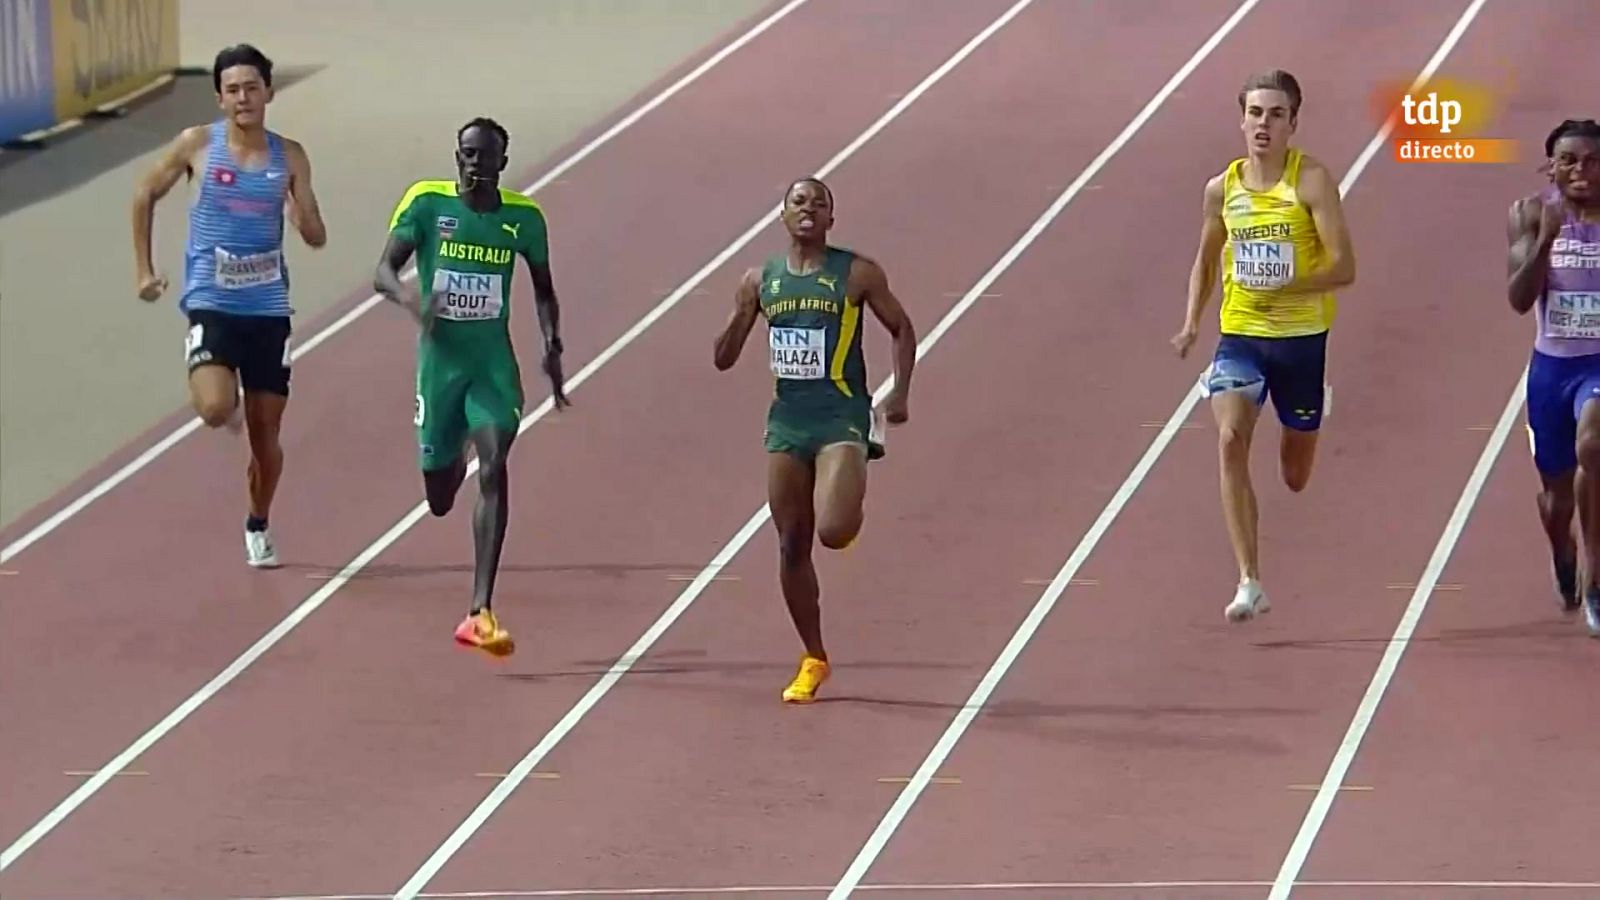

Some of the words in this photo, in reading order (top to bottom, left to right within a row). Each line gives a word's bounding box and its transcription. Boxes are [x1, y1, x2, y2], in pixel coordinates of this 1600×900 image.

[1231, 223, 1290, 240] SWEDEN
[439, 241, 511, 263] AUSTRALIA
[1240, 242, 1281, 259] NTN
[1235, 261, 1290, 278] TRULSSON
[447, 274, 491, 290] NTN
[447, 292, 489, 309] GOUT
[799, 297, 838, 314] AFRICA
[773, 328, 810, 346] NTN
